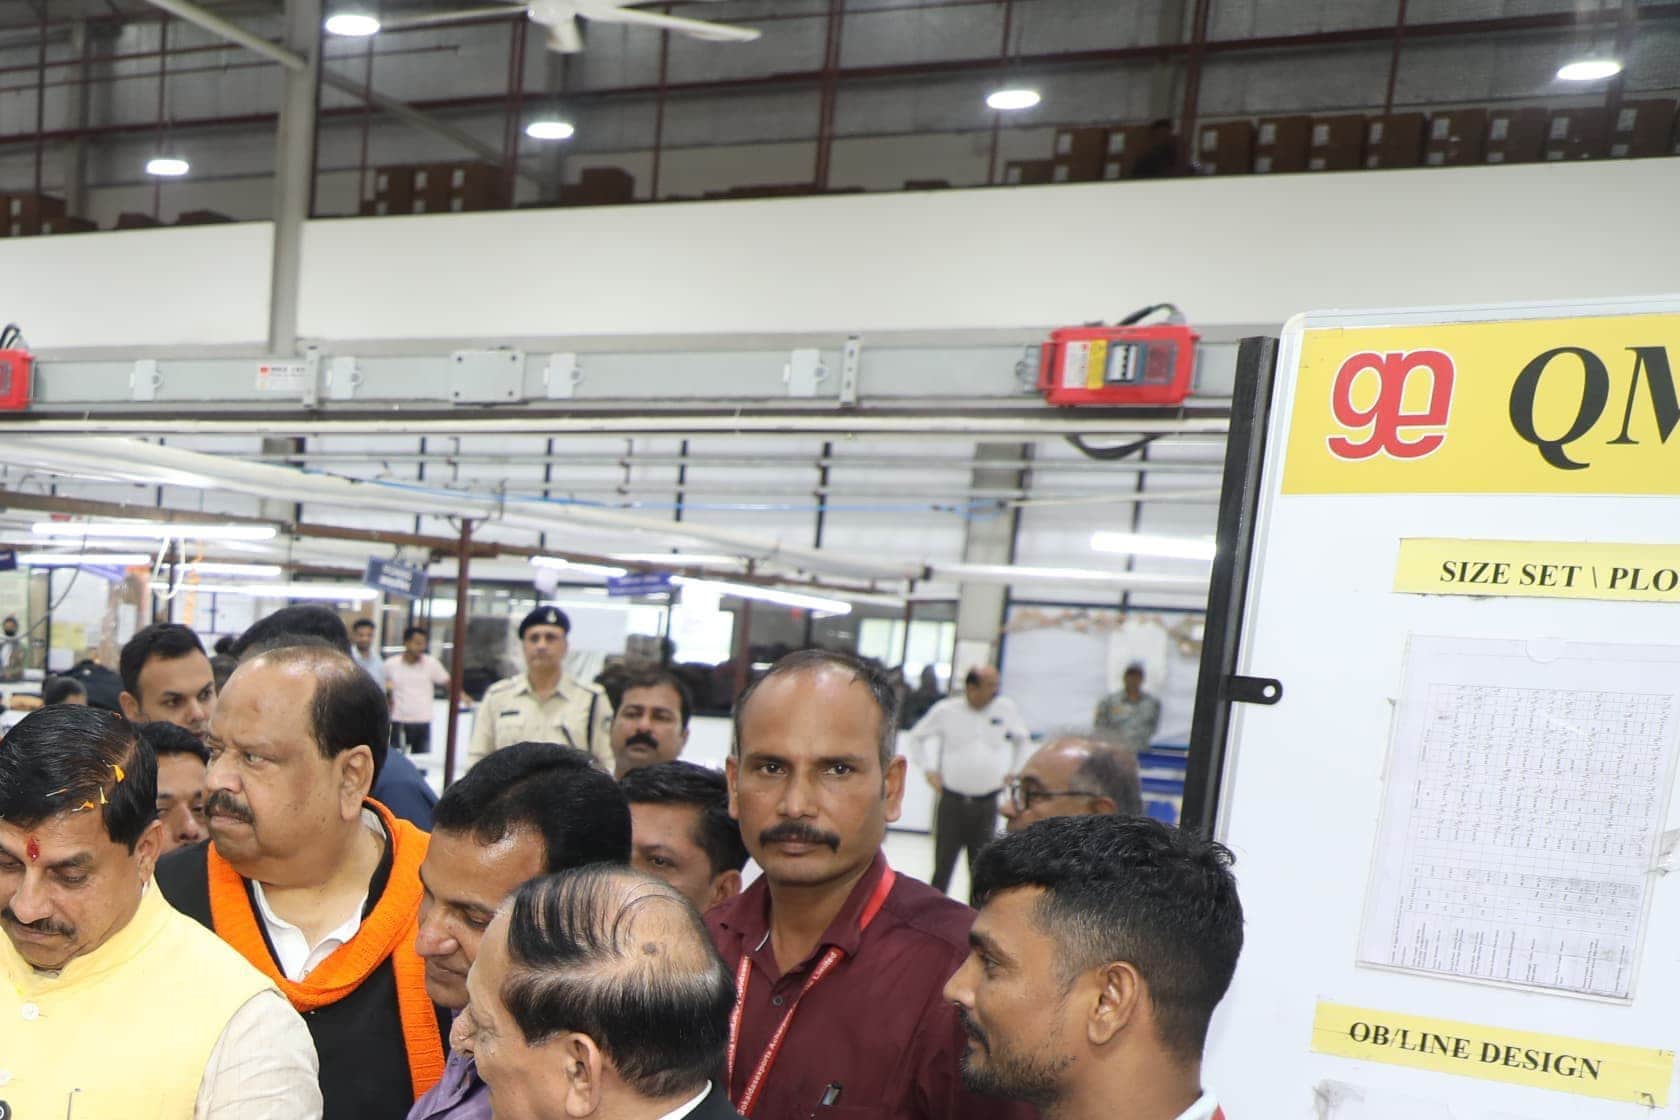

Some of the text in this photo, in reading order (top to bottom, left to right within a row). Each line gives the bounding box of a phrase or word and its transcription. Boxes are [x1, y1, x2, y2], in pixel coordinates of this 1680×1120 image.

[1439, 560, 1511, 585] SIZE
[1519, 563, 1583, 588] SET
[1348, 1021, 1603, 1081] OB/LINE DESIGN
